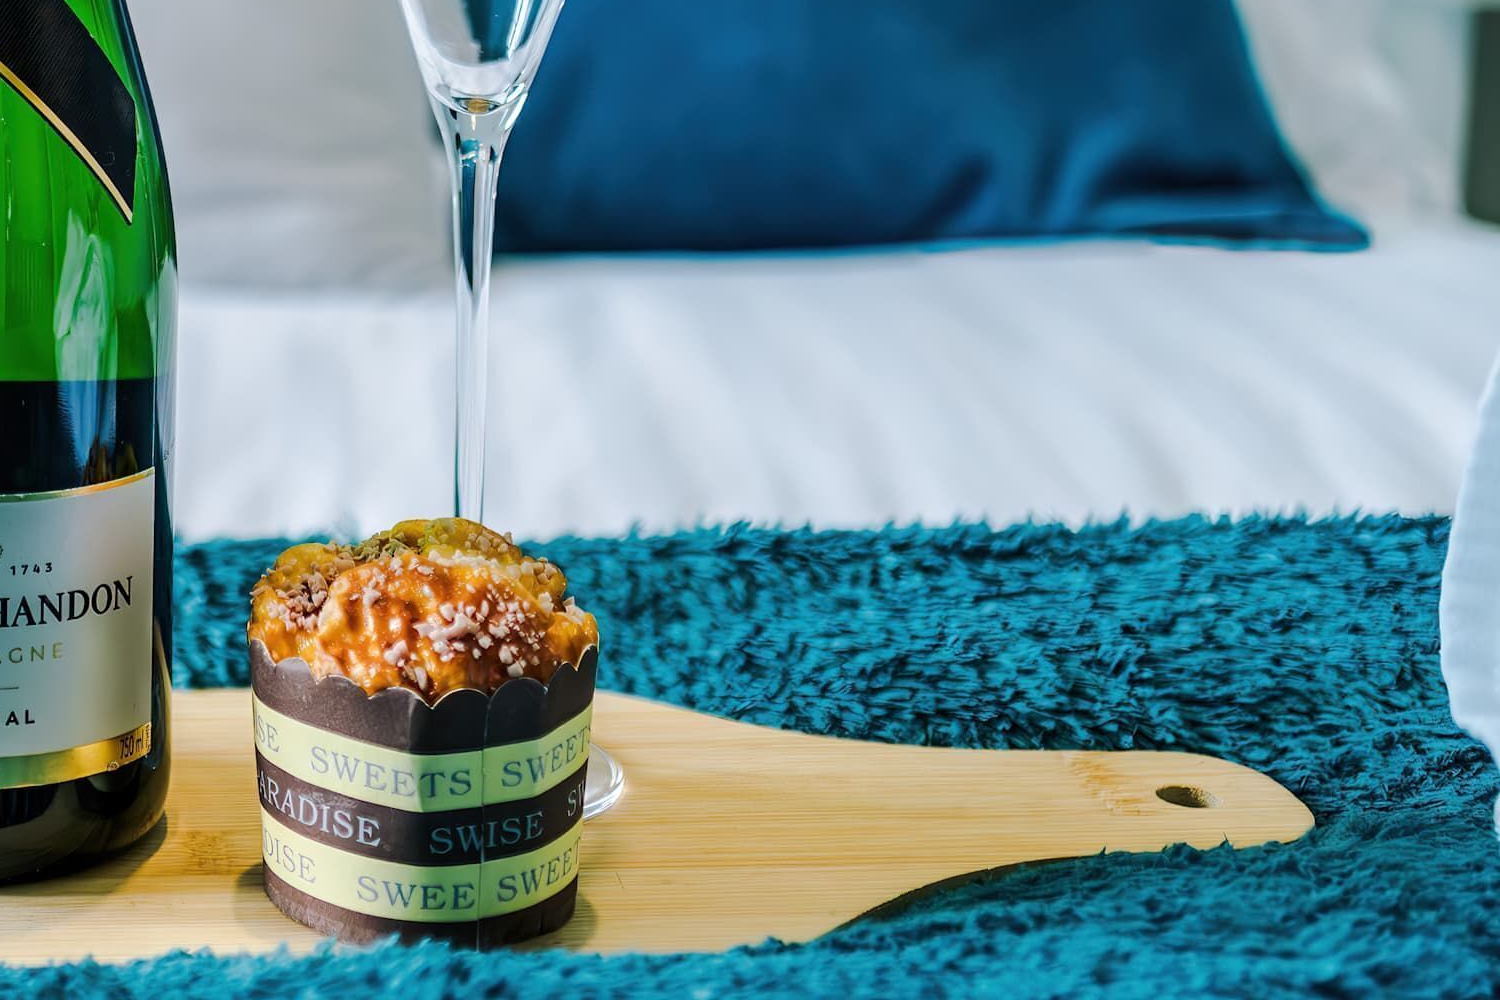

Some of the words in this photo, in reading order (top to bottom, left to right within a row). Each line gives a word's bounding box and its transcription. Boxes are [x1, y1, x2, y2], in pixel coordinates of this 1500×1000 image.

[9, 562, 53, 577] 1743
[310, 744, 472, 798] SWEETS
[256, 769, 382, 847] ARADISE
[429, 811, 544, 855] SWISE
[356, 874, 476, 911] SWEE
